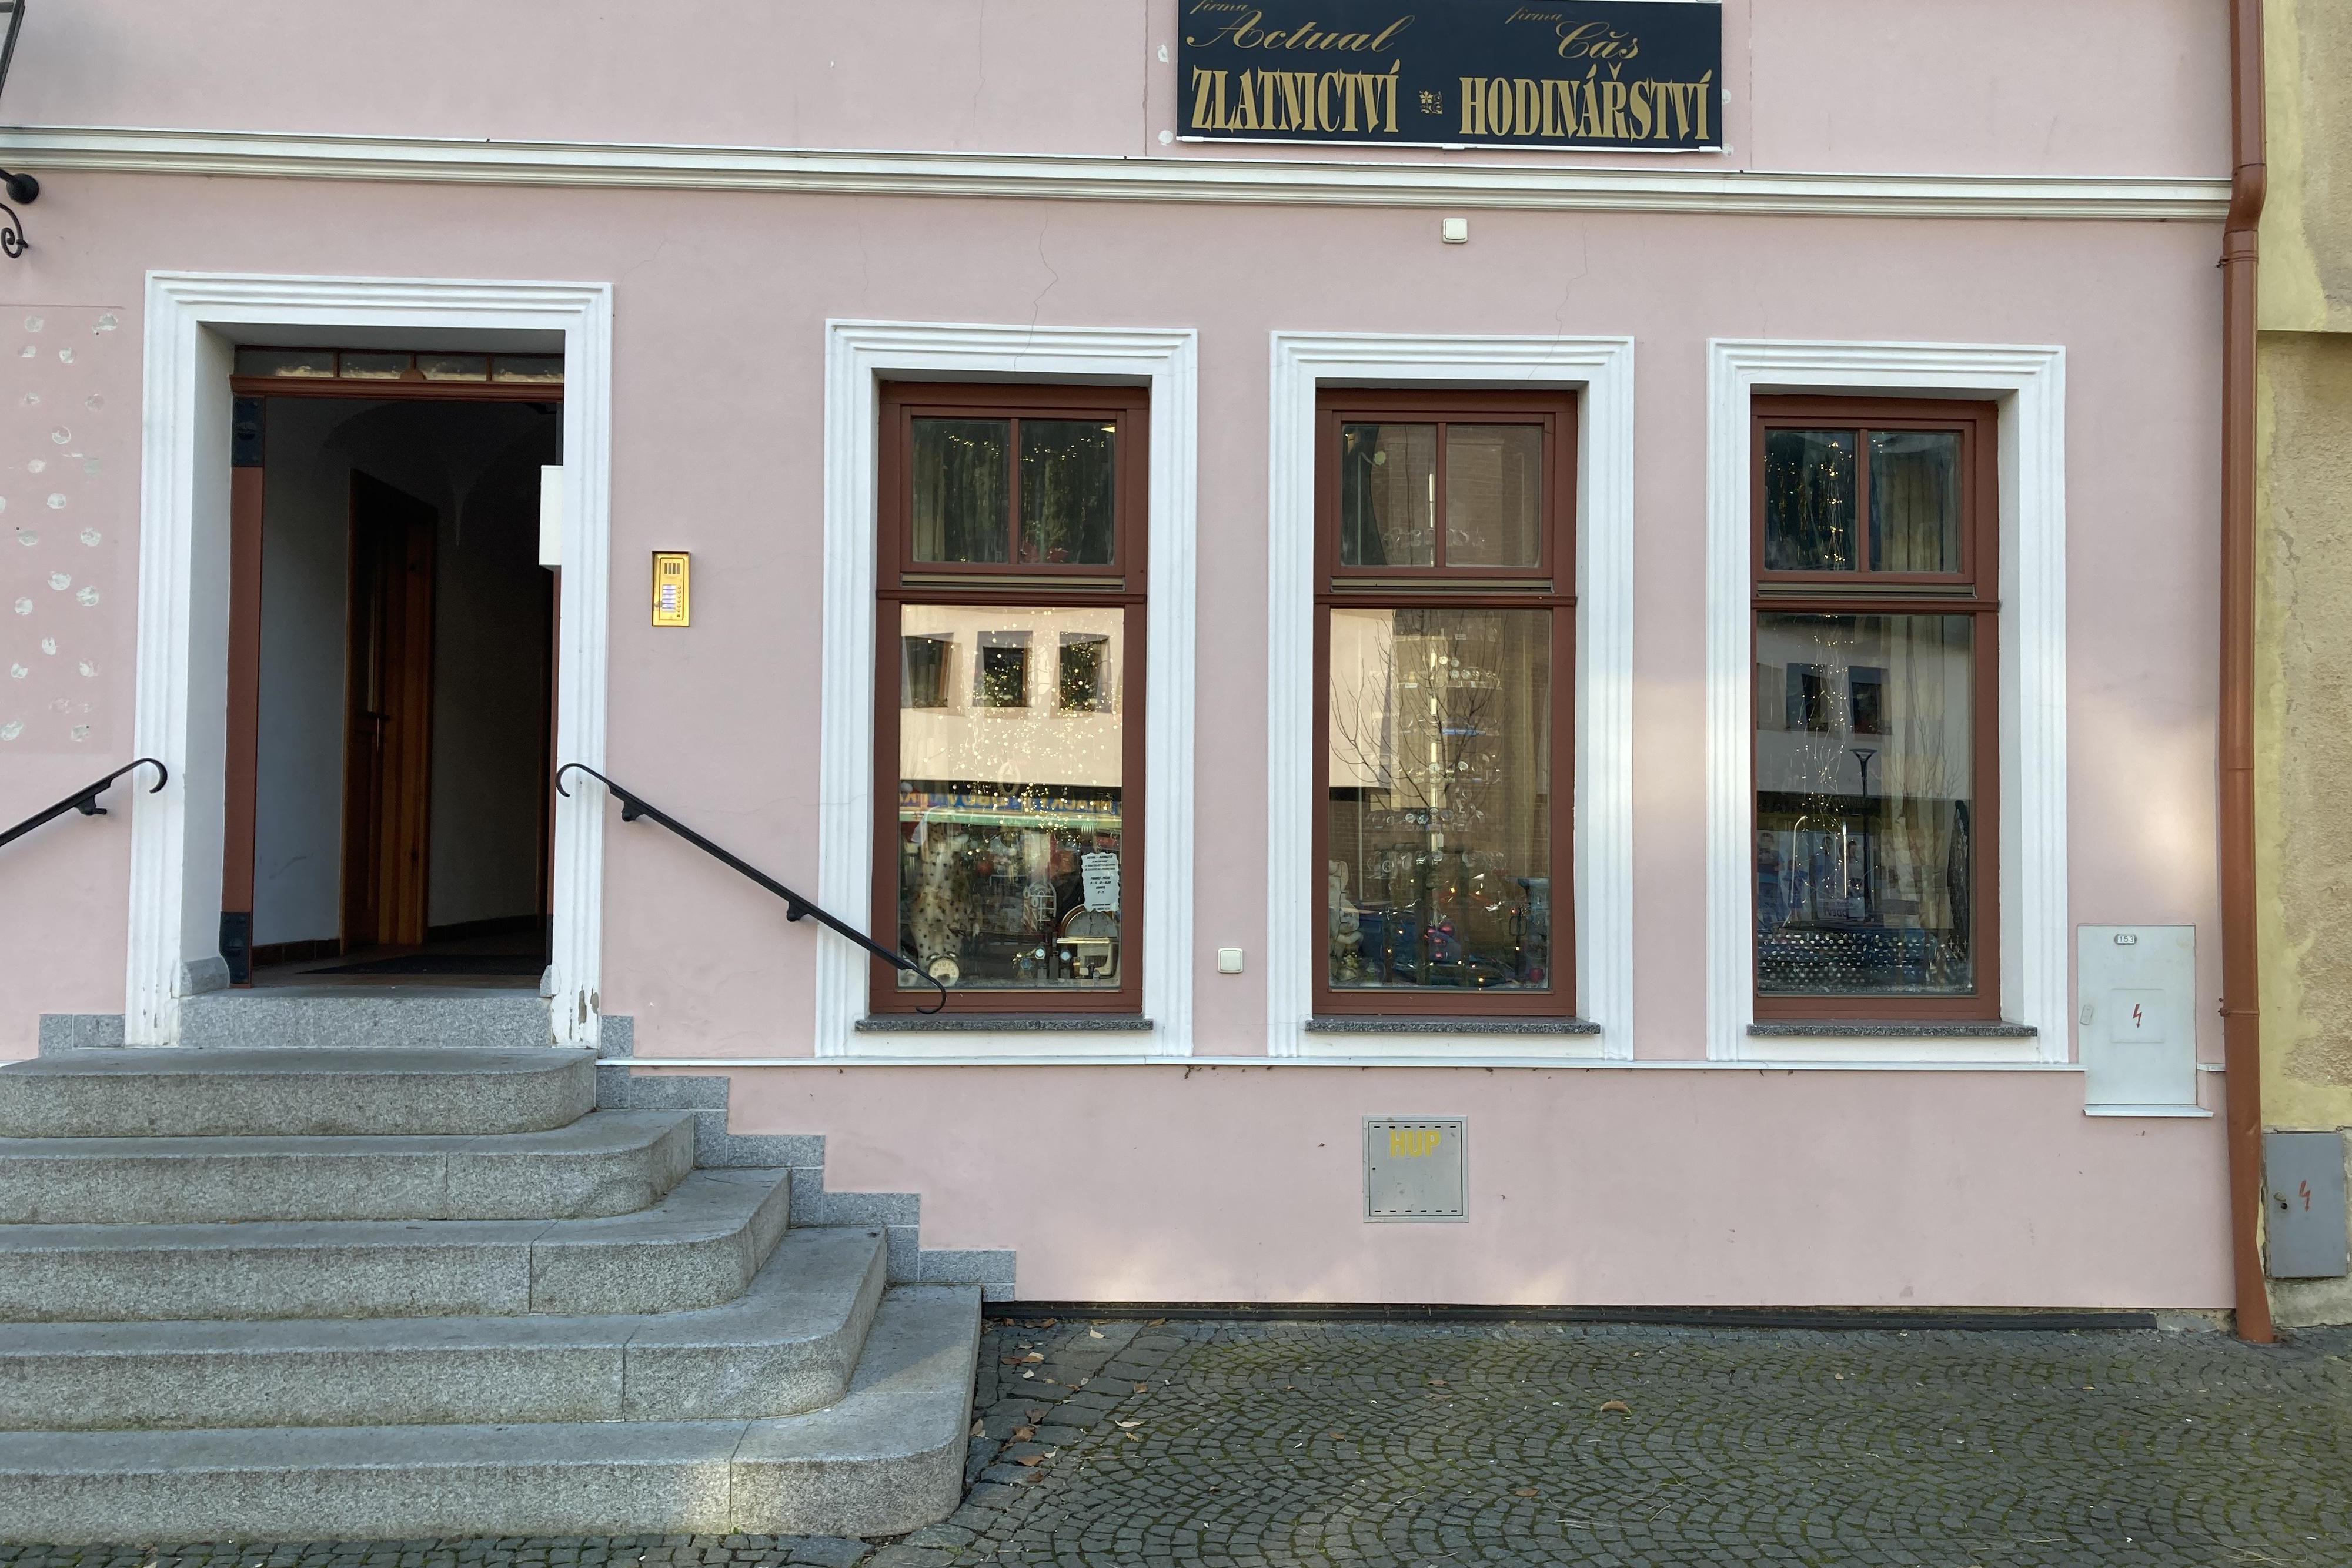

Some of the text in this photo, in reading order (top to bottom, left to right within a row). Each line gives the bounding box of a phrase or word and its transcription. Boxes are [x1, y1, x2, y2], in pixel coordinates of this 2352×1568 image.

[1189, 0, 1248, 15] firma
[1504, 6, 1562, 24] firma
[1186, 9, 1415, 52] Actual
[1191, 59, 1712, 143] ZLATNICTVÍ HODINÁŘSTVÍ
[1389, 1129, 1441, 1158] HUP
